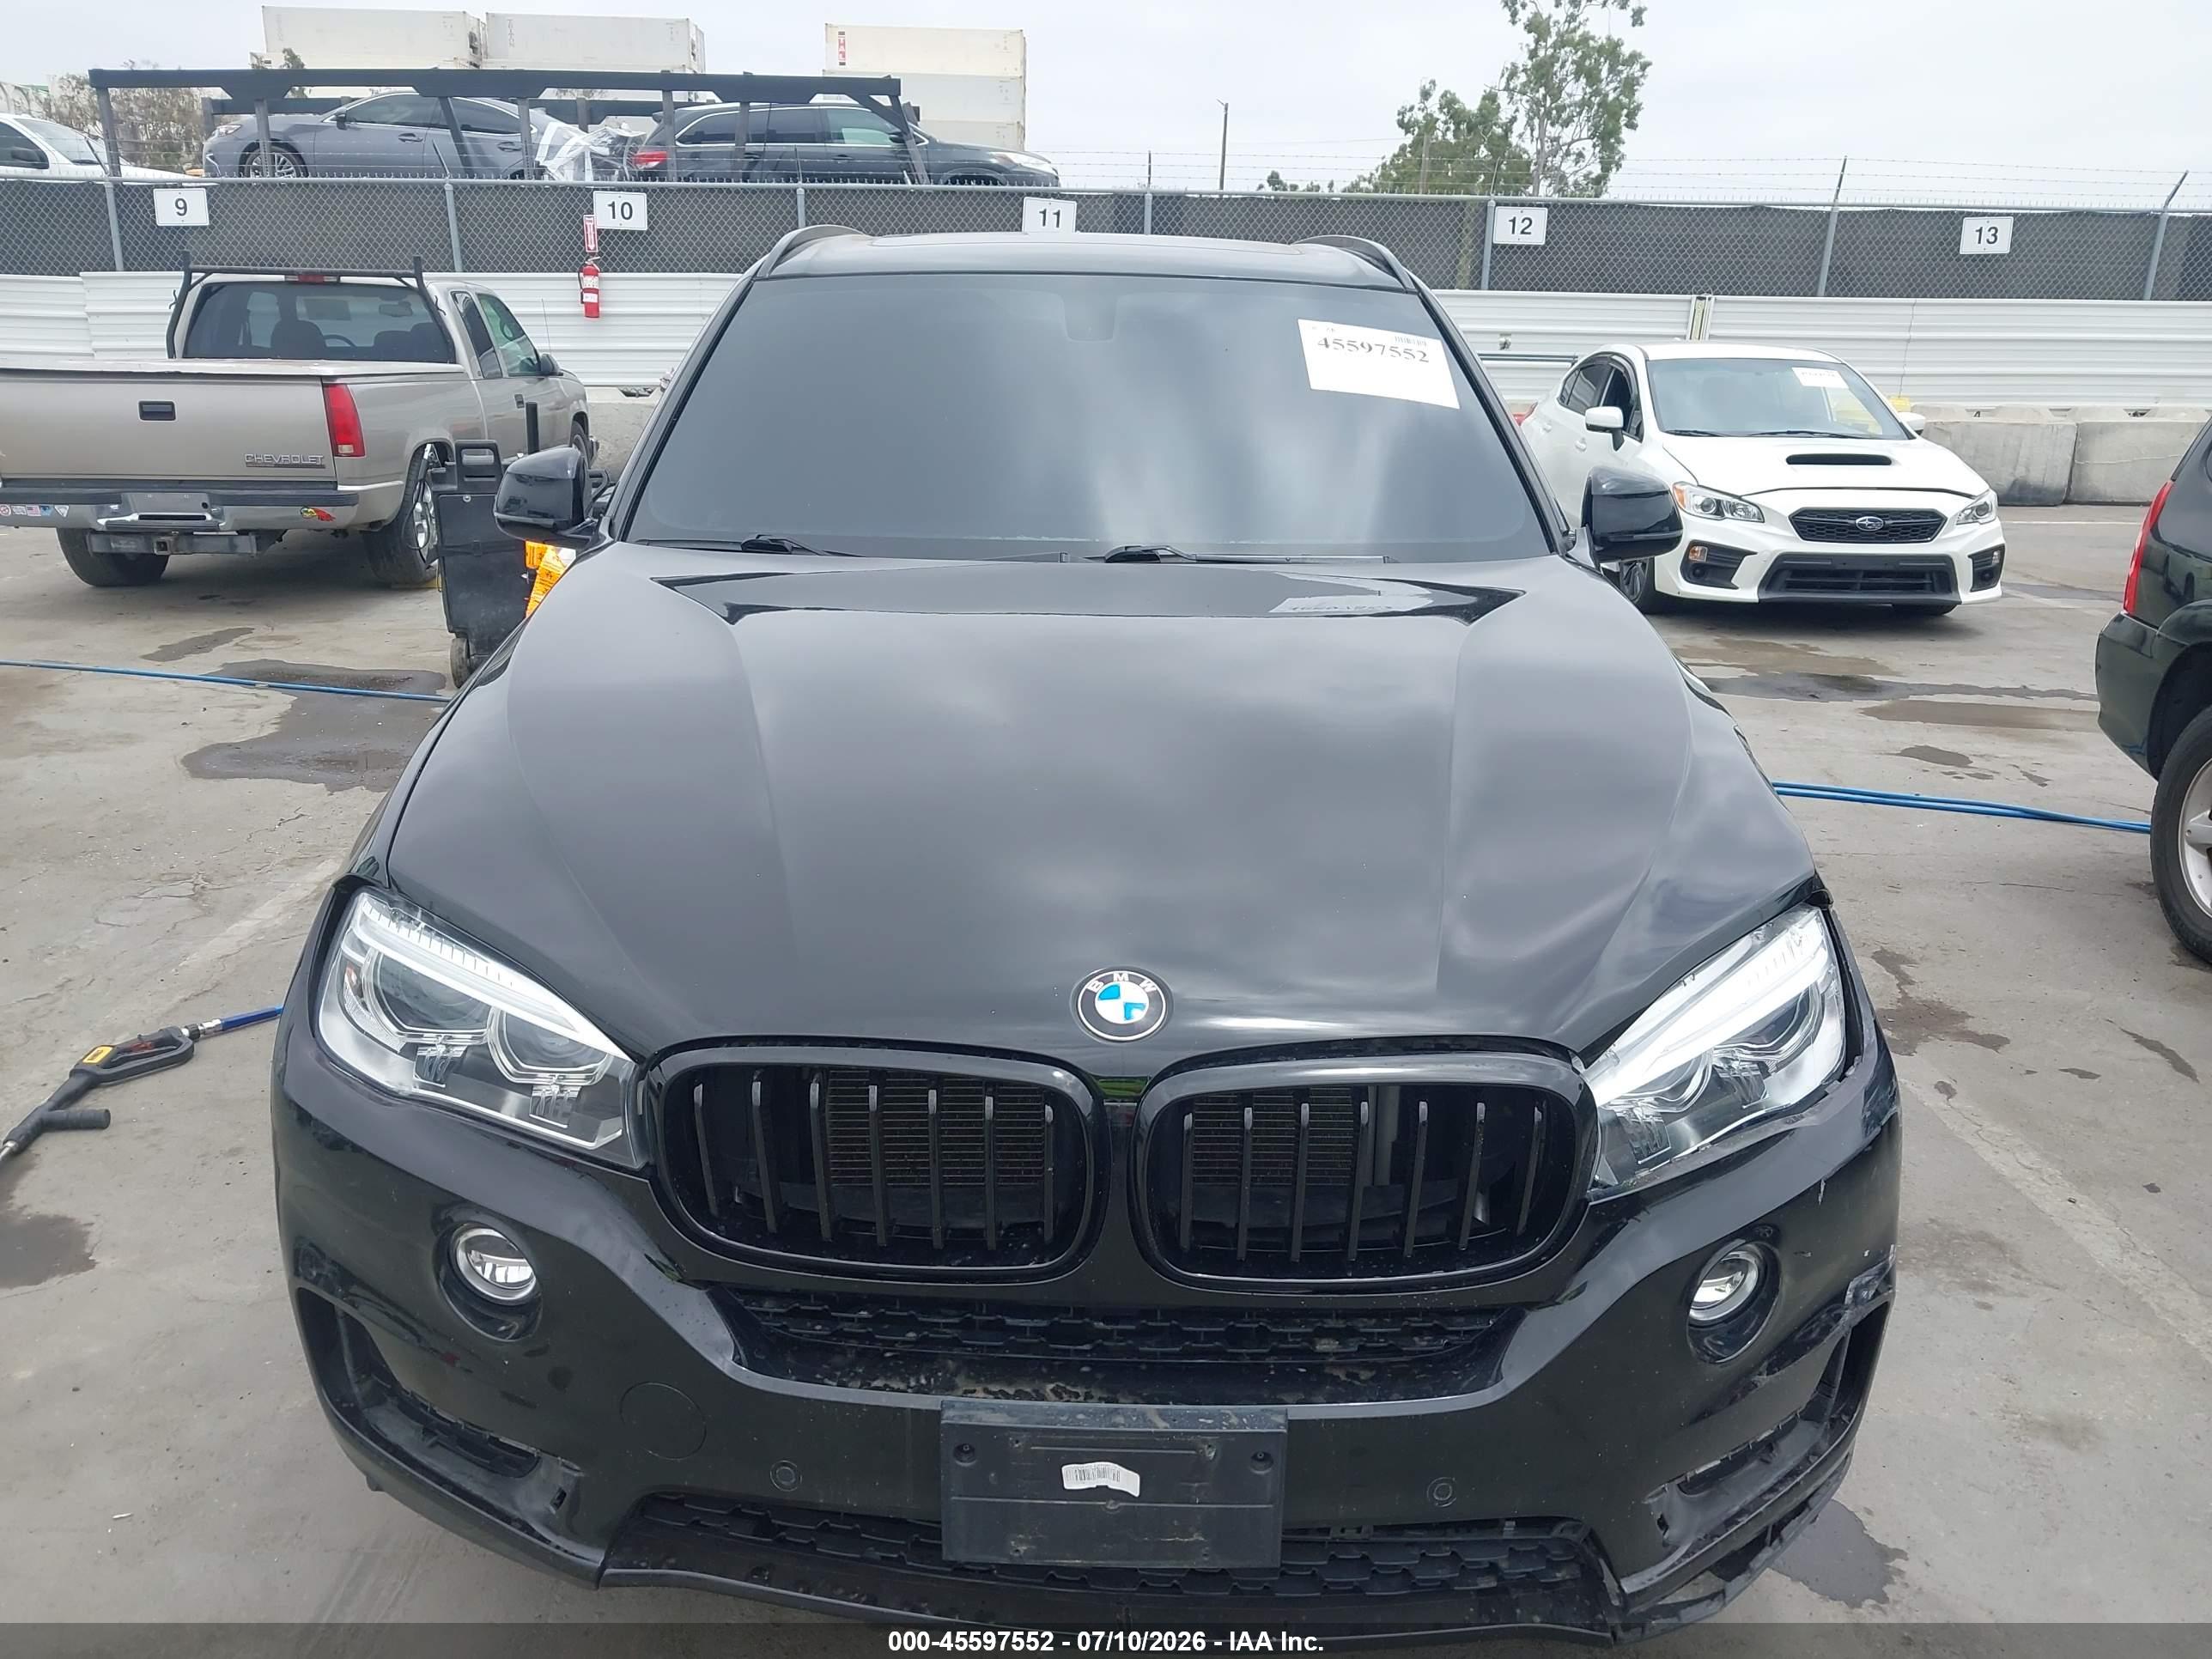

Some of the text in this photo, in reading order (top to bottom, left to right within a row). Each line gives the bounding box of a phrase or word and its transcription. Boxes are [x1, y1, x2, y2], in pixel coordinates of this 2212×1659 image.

[174, 198, 188, 216] 9
[607, 201, 634, 221] 10
[1039, 208, 1060, 228] 11
[1508, 216, 1533, 235] 12
[1975, 226, 1999, 245] 13
[1317, 337, 1430, 363] 45597552
[244, 453, 325, 465] CHEVROLET
[1085, 971, 1158, 994] BMW
